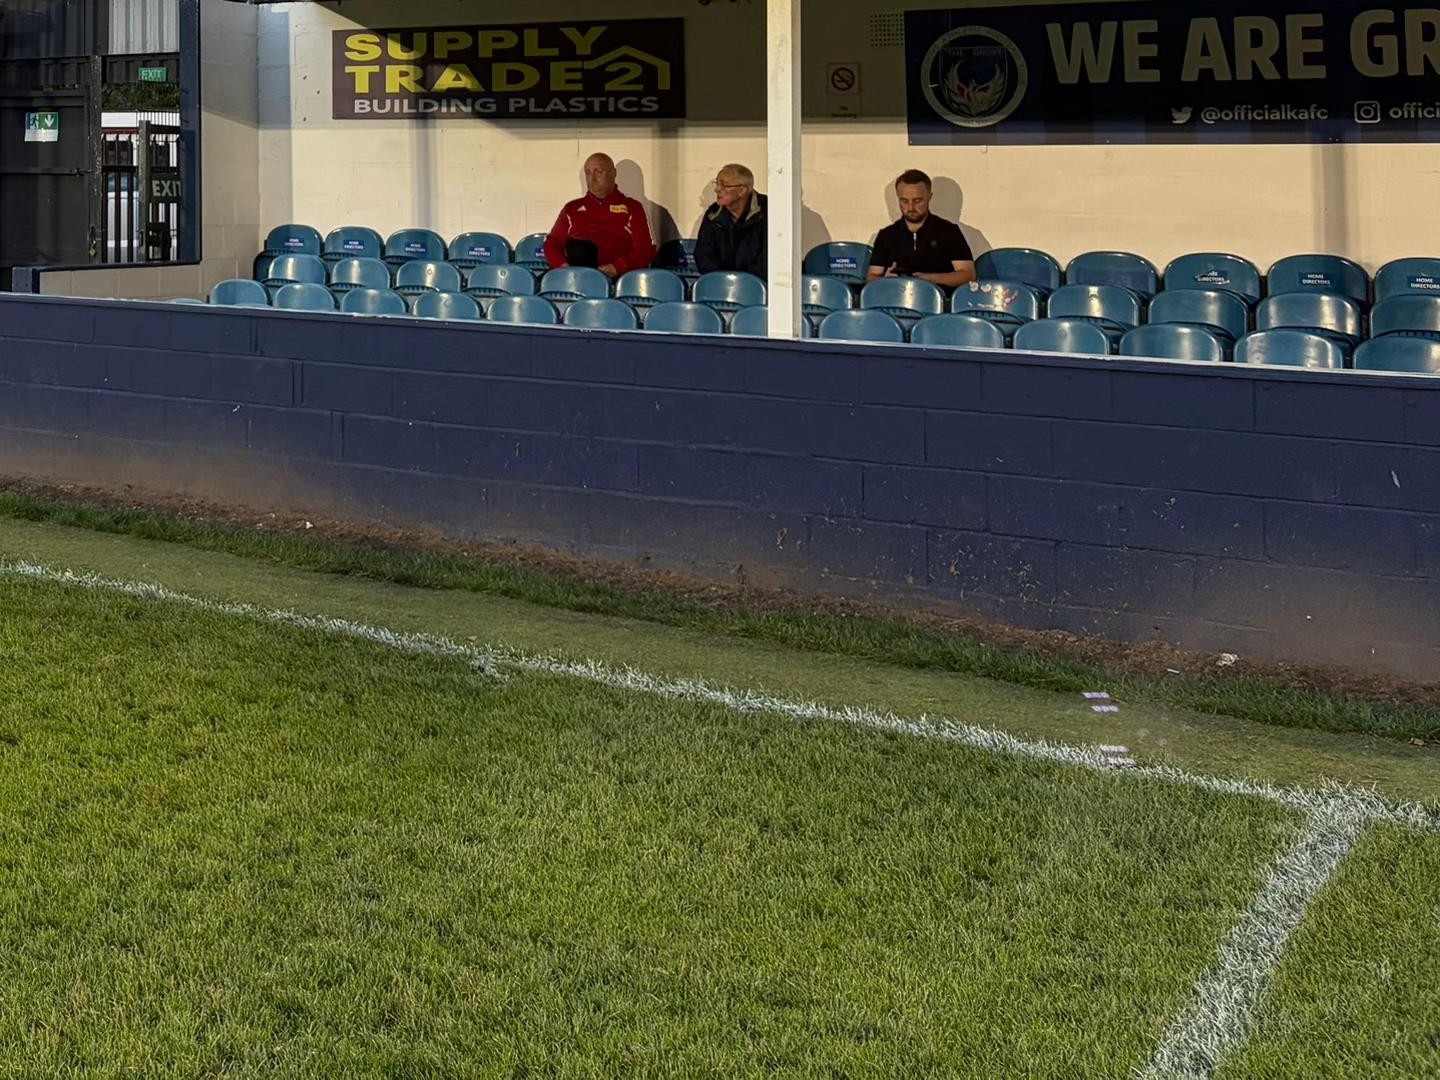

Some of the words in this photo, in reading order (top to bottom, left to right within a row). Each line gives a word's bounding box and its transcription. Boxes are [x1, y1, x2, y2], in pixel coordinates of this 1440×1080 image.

[344, 25, 608, 61] SUPPLY
[1045, 20, 1160, 85] WE
[1180, 13, 1327, 81] ARE
[1350, 8, 1440, 78] GR
[141, 69, 163, 80] EXIT
[344, 61, 584, 94] TRADE
[353, 98, 497, 114] BUILDING
[508, 96, 659, 113] PLASTICS
[1201, 104, 1329, 125] @officialkafc
[152, 179, 181, 197] EXIT
